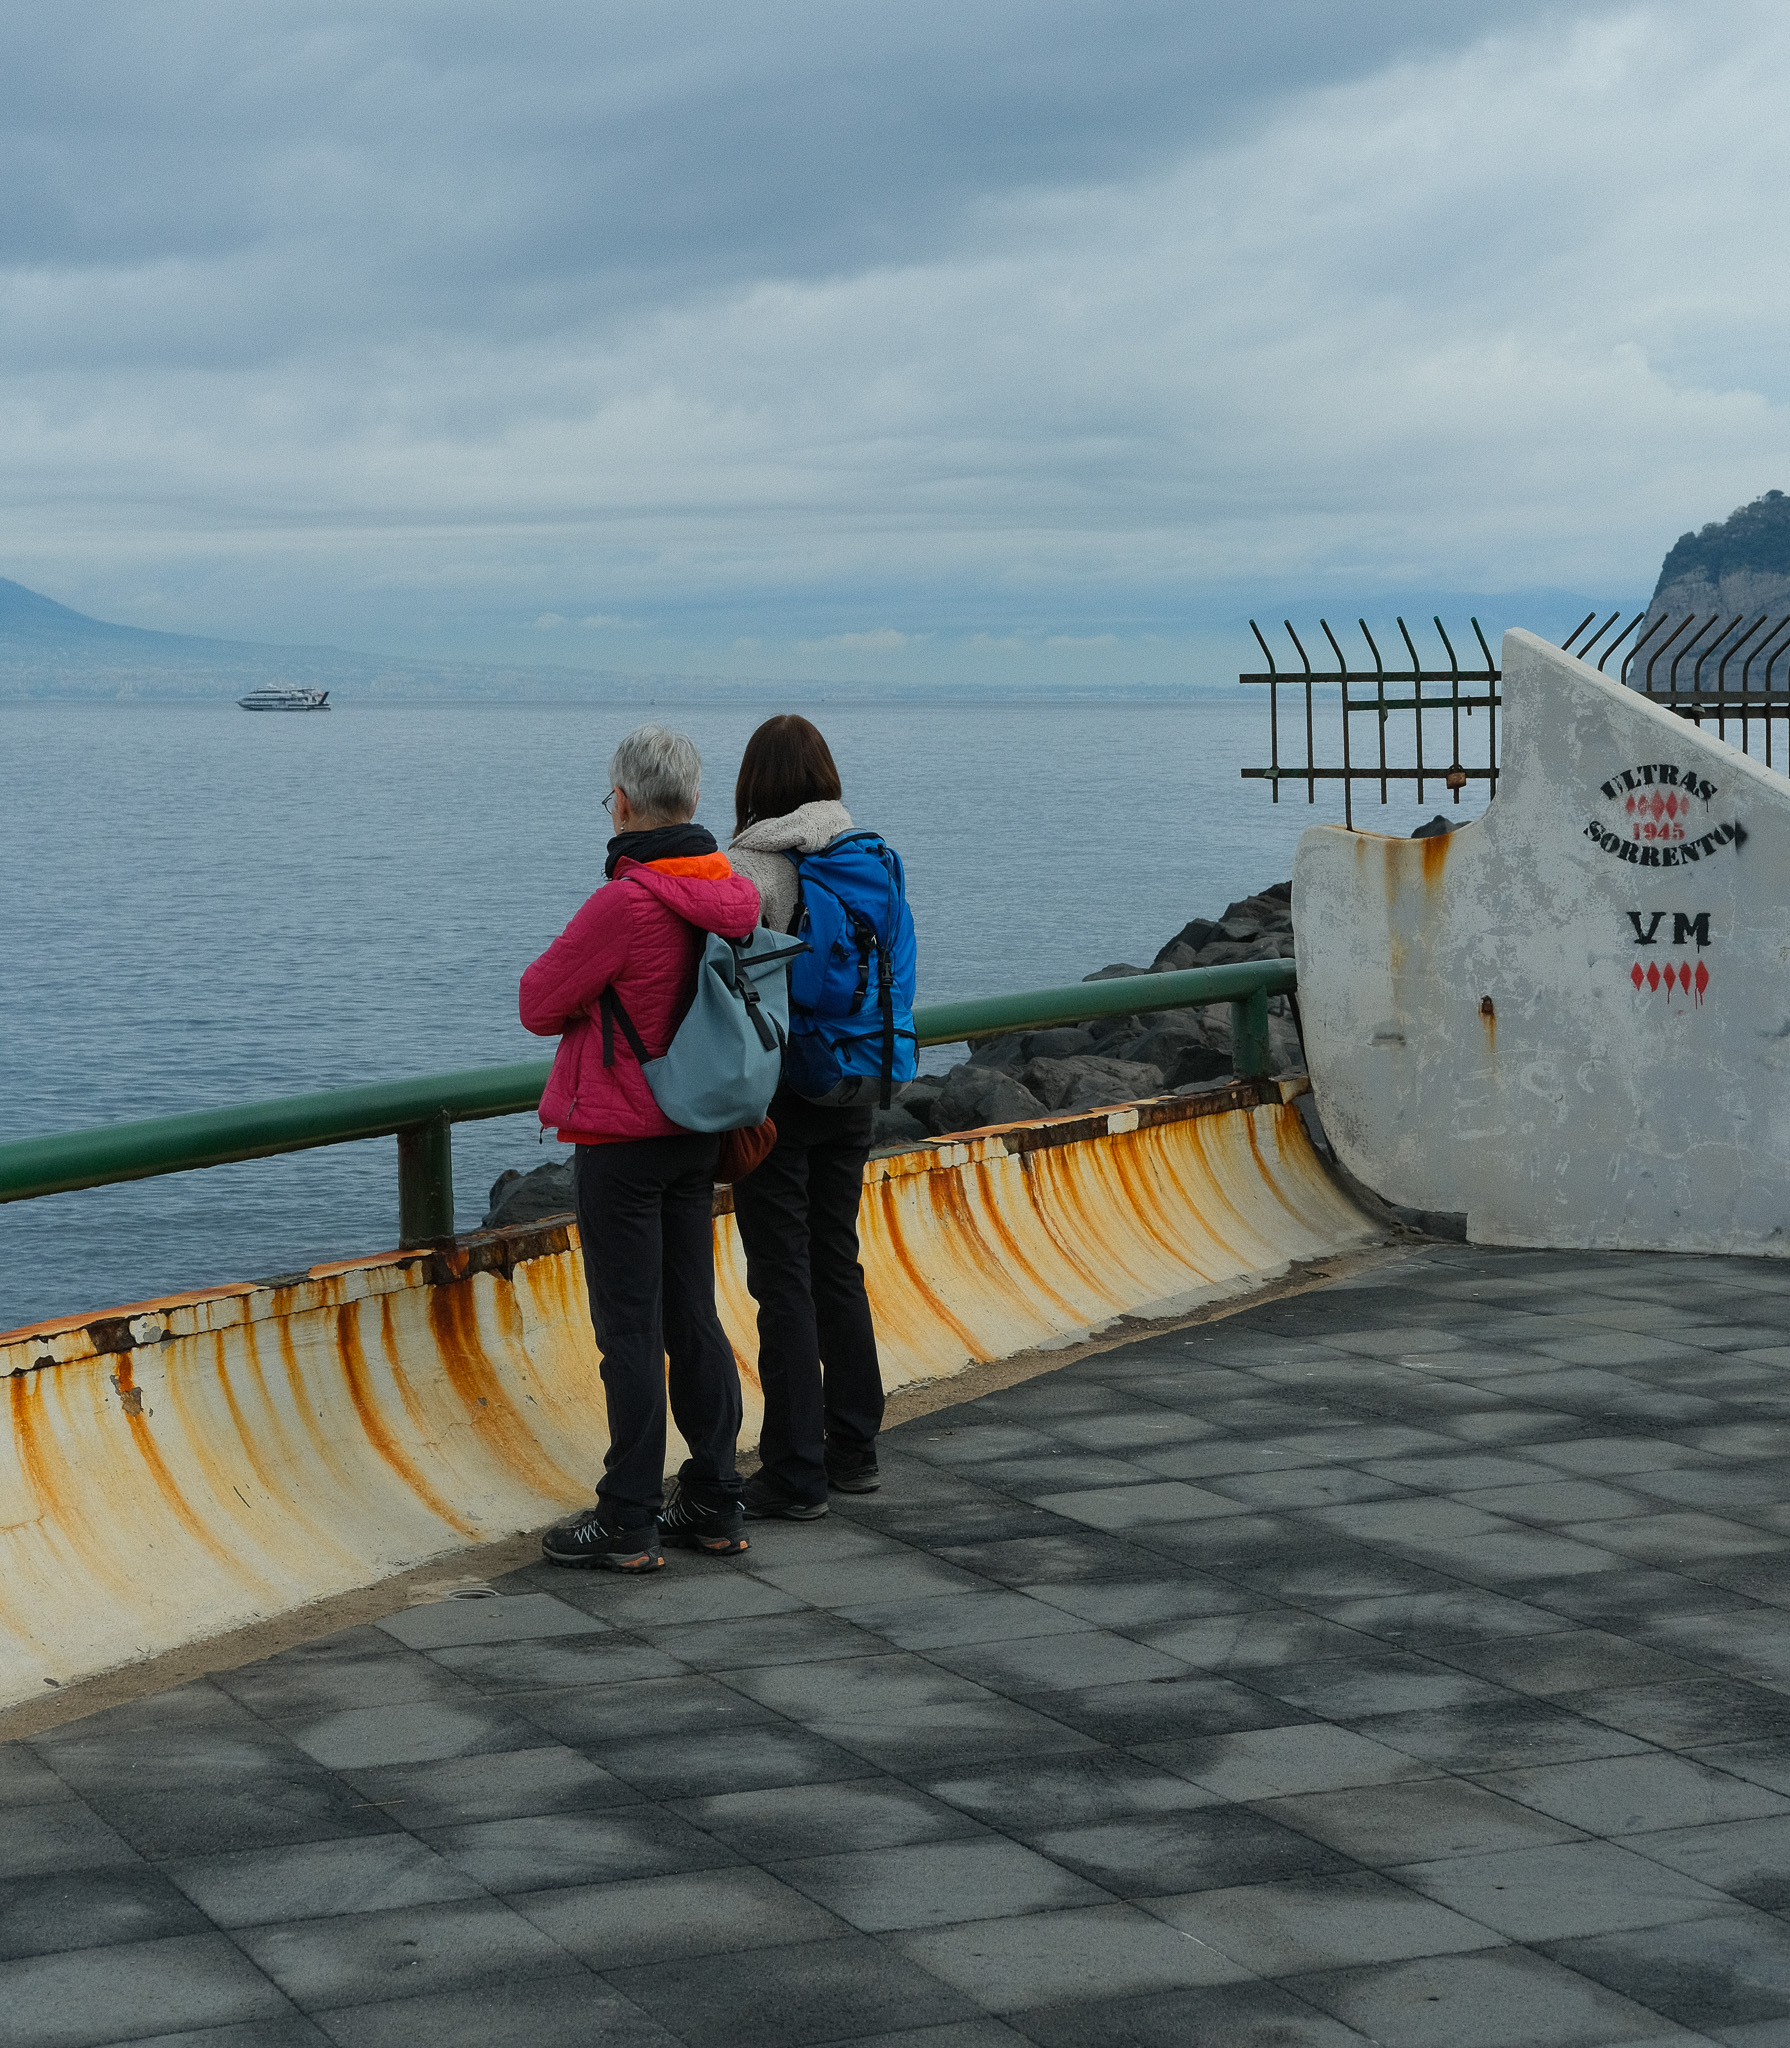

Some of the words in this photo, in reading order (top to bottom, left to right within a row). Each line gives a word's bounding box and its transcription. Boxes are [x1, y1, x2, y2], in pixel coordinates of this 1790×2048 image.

[1600, 764, 1717, 801] ULTRAS
[1583, 821, 1735, 867] SORRENTO
[1633, 823, 1685, 841] 1945
